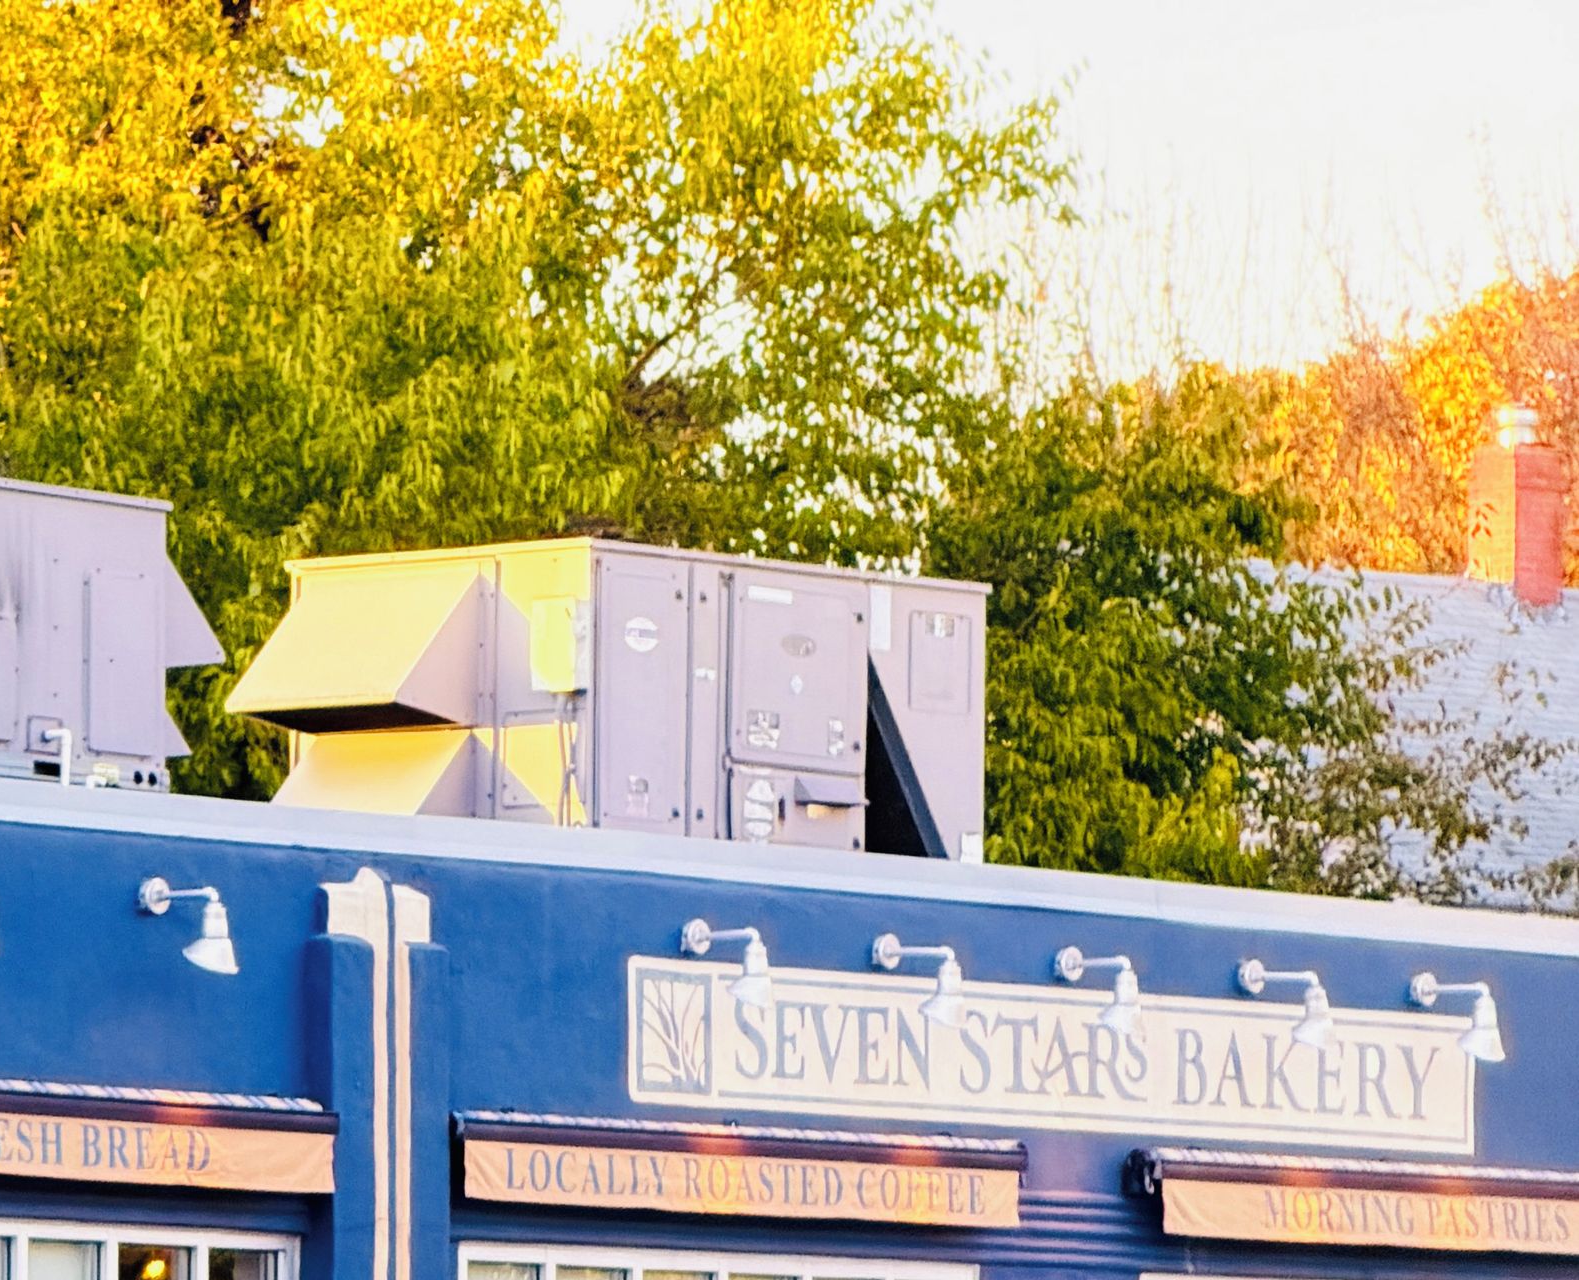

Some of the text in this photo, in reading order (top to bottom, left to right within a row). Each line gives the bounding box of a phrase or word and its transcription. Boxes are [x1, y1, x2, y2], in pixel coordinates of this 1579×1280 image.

[733, 997, 1441, 1121] SEVEN STARS BAKERY
[80, 1123, 212, 1172] BREAD
[505, 1147, 987, 1216] LOCALLY ROASTED COFFEE
[1261, 1189, 1572, 1243] MORNING PASTRIES
